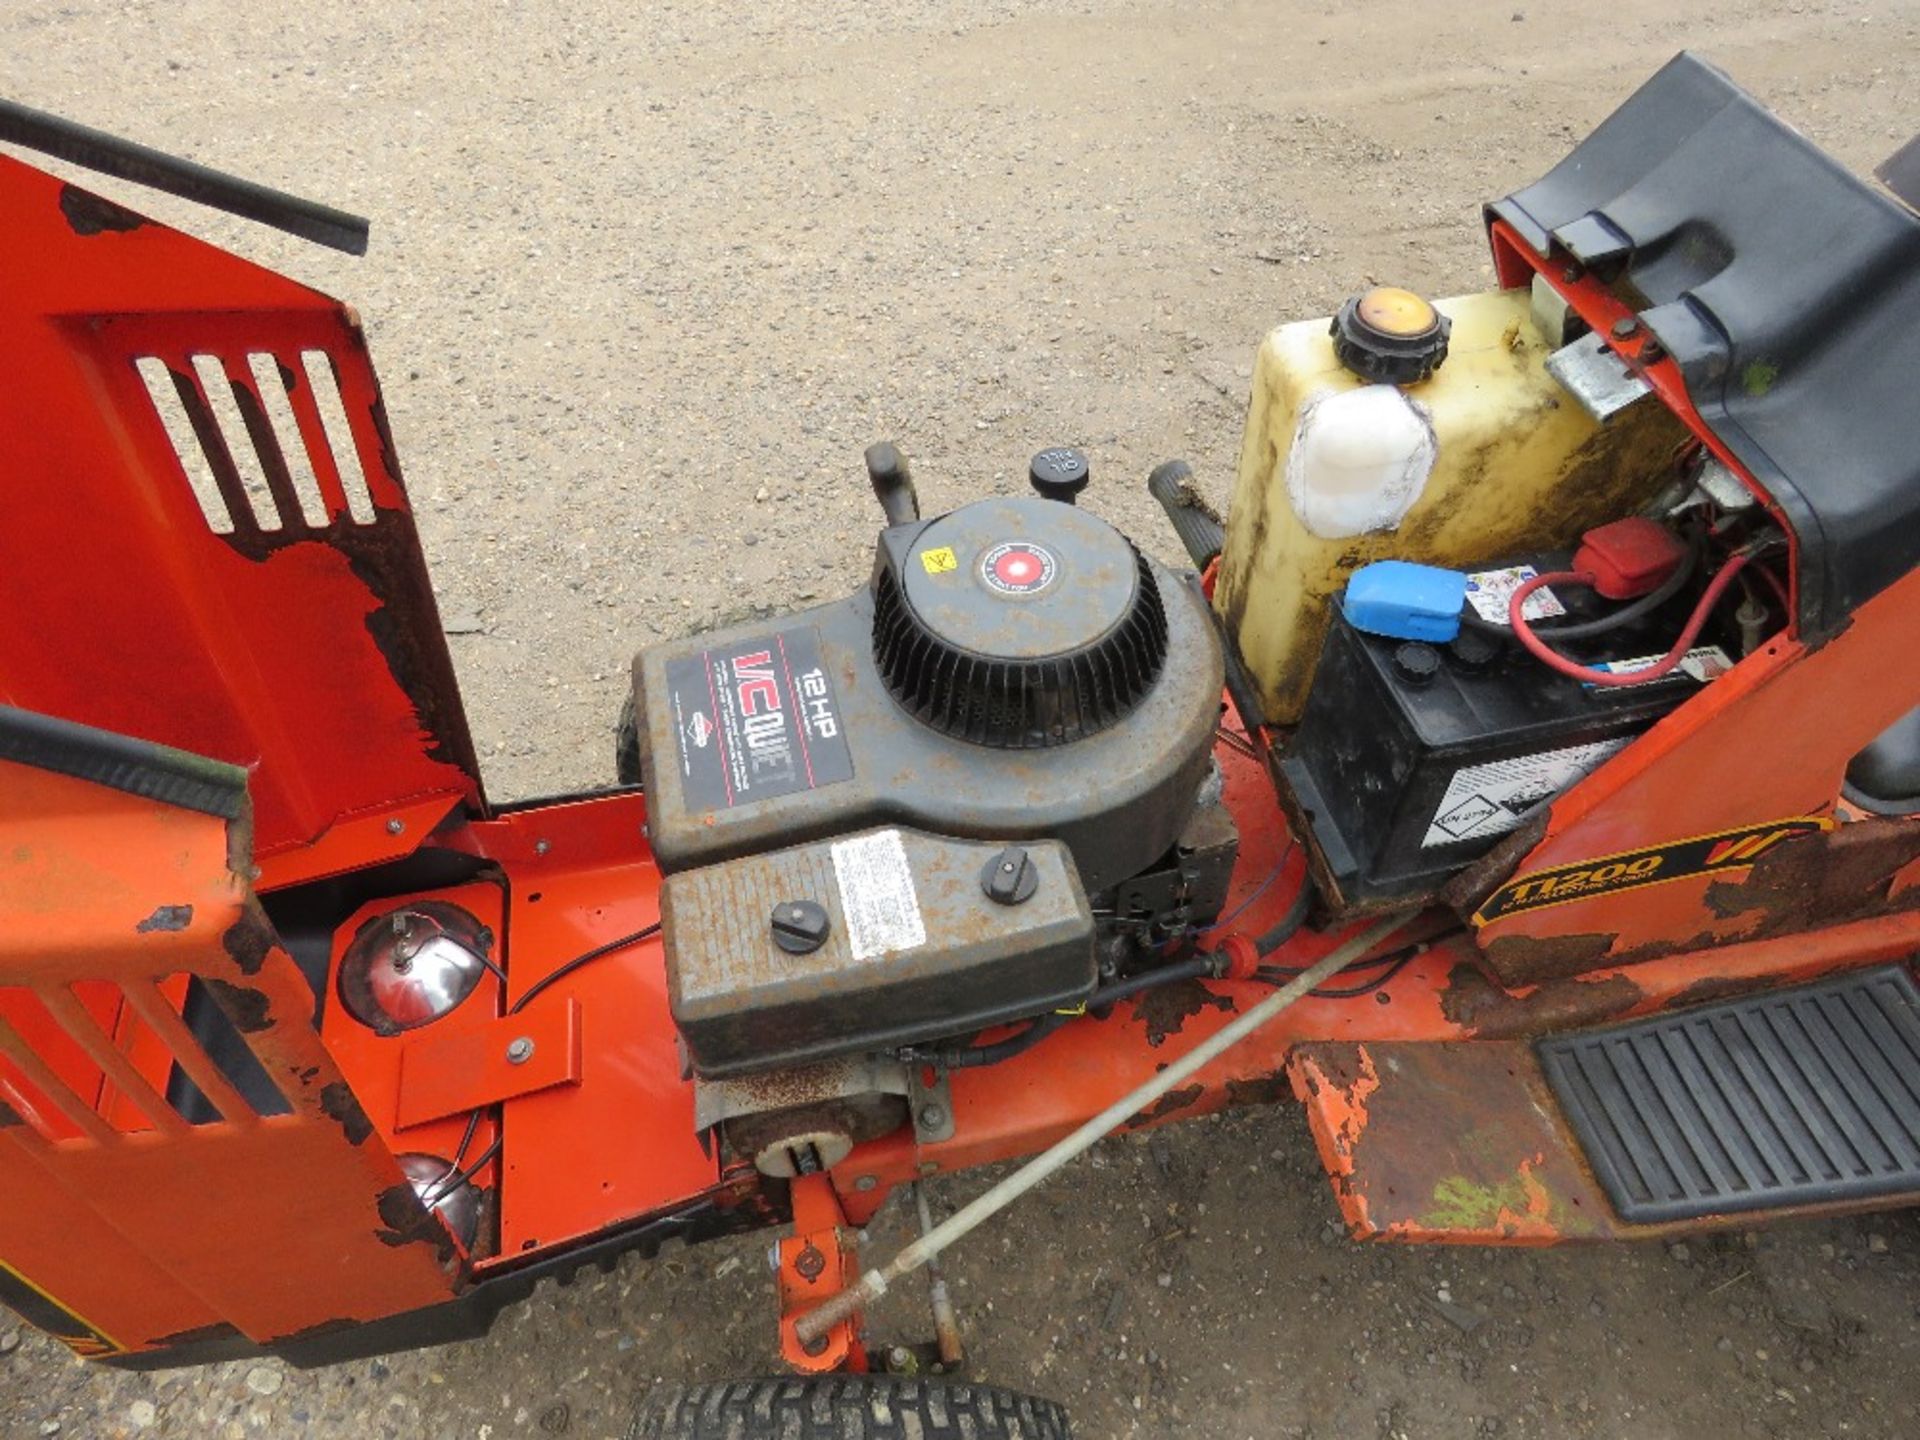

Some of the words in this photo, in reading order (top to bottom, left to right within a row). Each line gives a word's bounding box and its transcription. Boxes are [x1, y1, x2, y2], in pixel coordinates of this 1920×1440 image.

[1050, 460, 1079, 472] OIL
[802, 667, 826, 697] 12
[808, 698, 838, 738] HP
[1509, 855, 1664, 901] T1200
